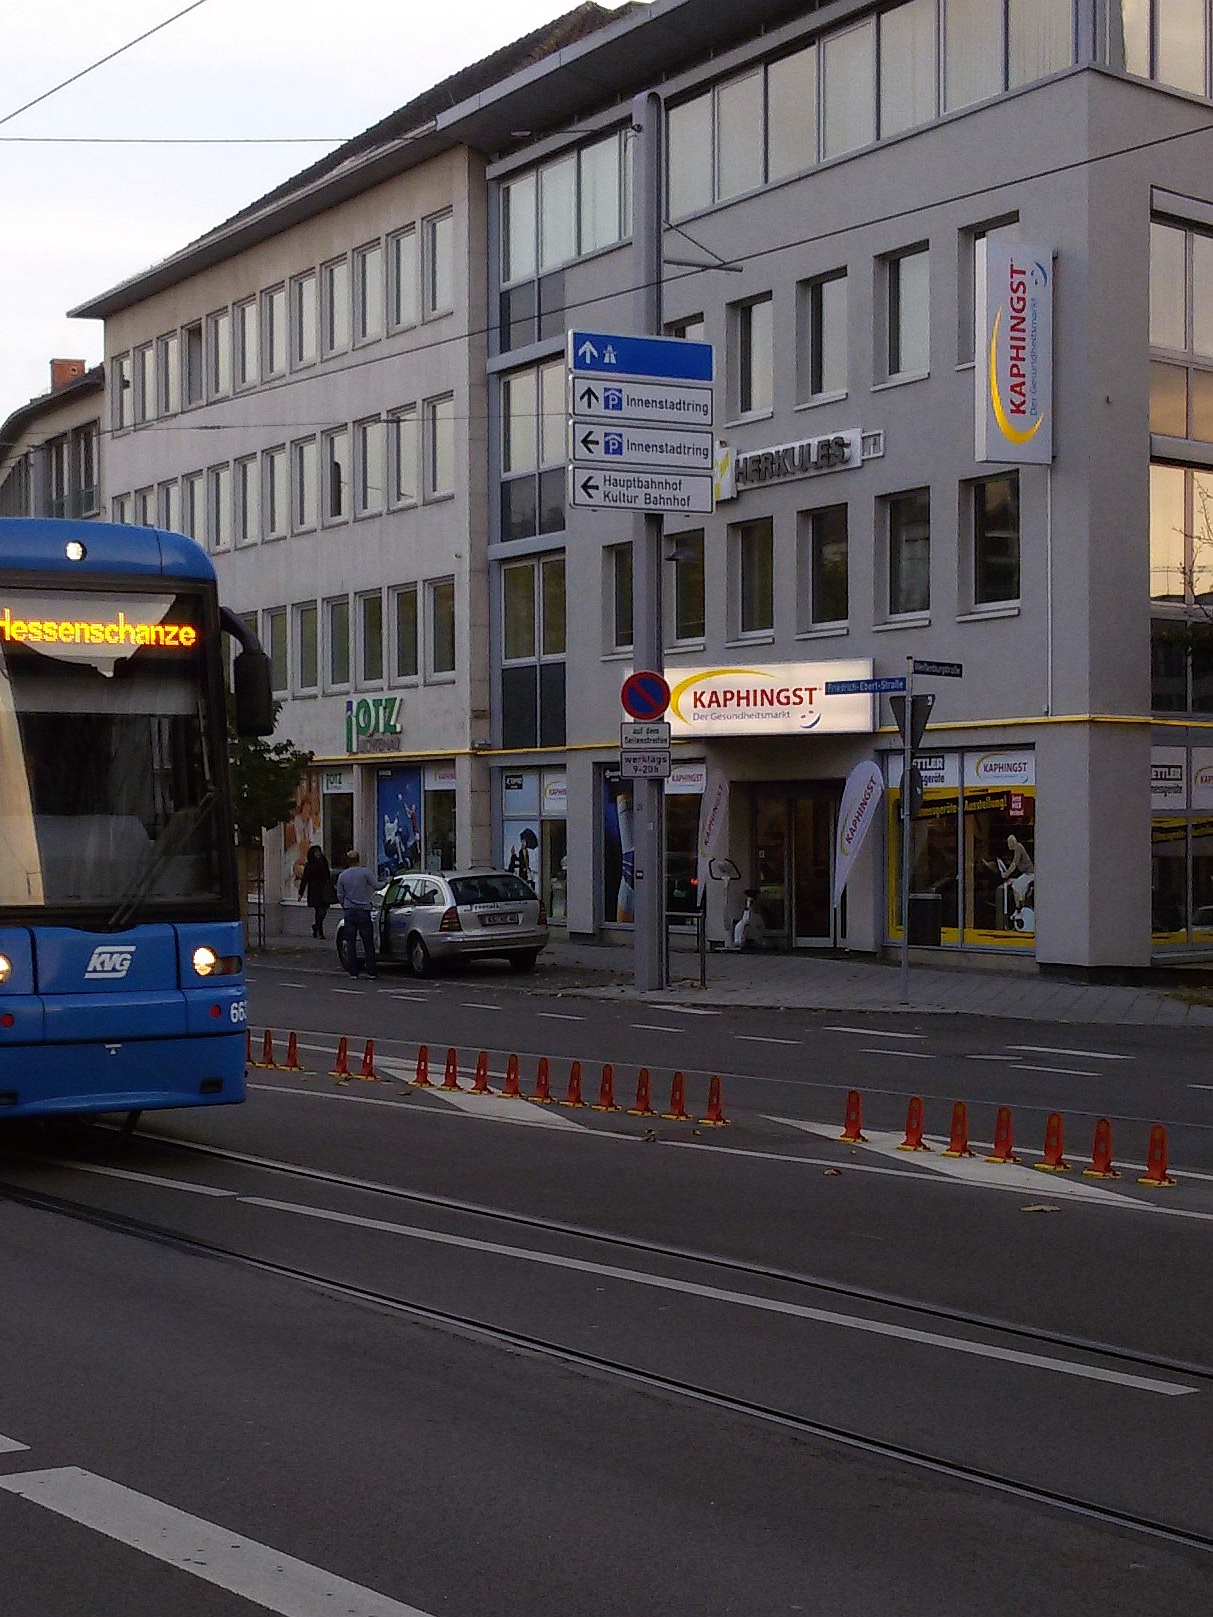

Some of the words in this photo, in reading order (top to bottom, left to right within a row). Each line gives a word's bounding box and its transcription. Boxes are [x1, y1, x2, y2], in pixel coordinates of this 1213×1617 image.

[1009, 265, 1028, 415] KAPHINGST
[626, 394, 709, 415] Innenstadtring
[626, 438, 709, 459] Innenstadtring
[734, 436, 851, 484] HERKULES
[603, 474, 683, 493] Hauptbahnhof
[603, 491, 639, 505] Kultur
[644, 494, 691, 508] Bahnhof
[693, 687, 818, 709] KAPHINGST
[692, 711, 710, 721] Der
[711, 710, 791, 721] Gesundheitsmarkt
[646, 727, 659, 735] dem
[624, 755, 667, 765] werktags
[983, 762, 1028, 773] KAPHINGST
[846, 773, 877, 845] KAPHINGST
[86, 951, 133, 974] KVG
